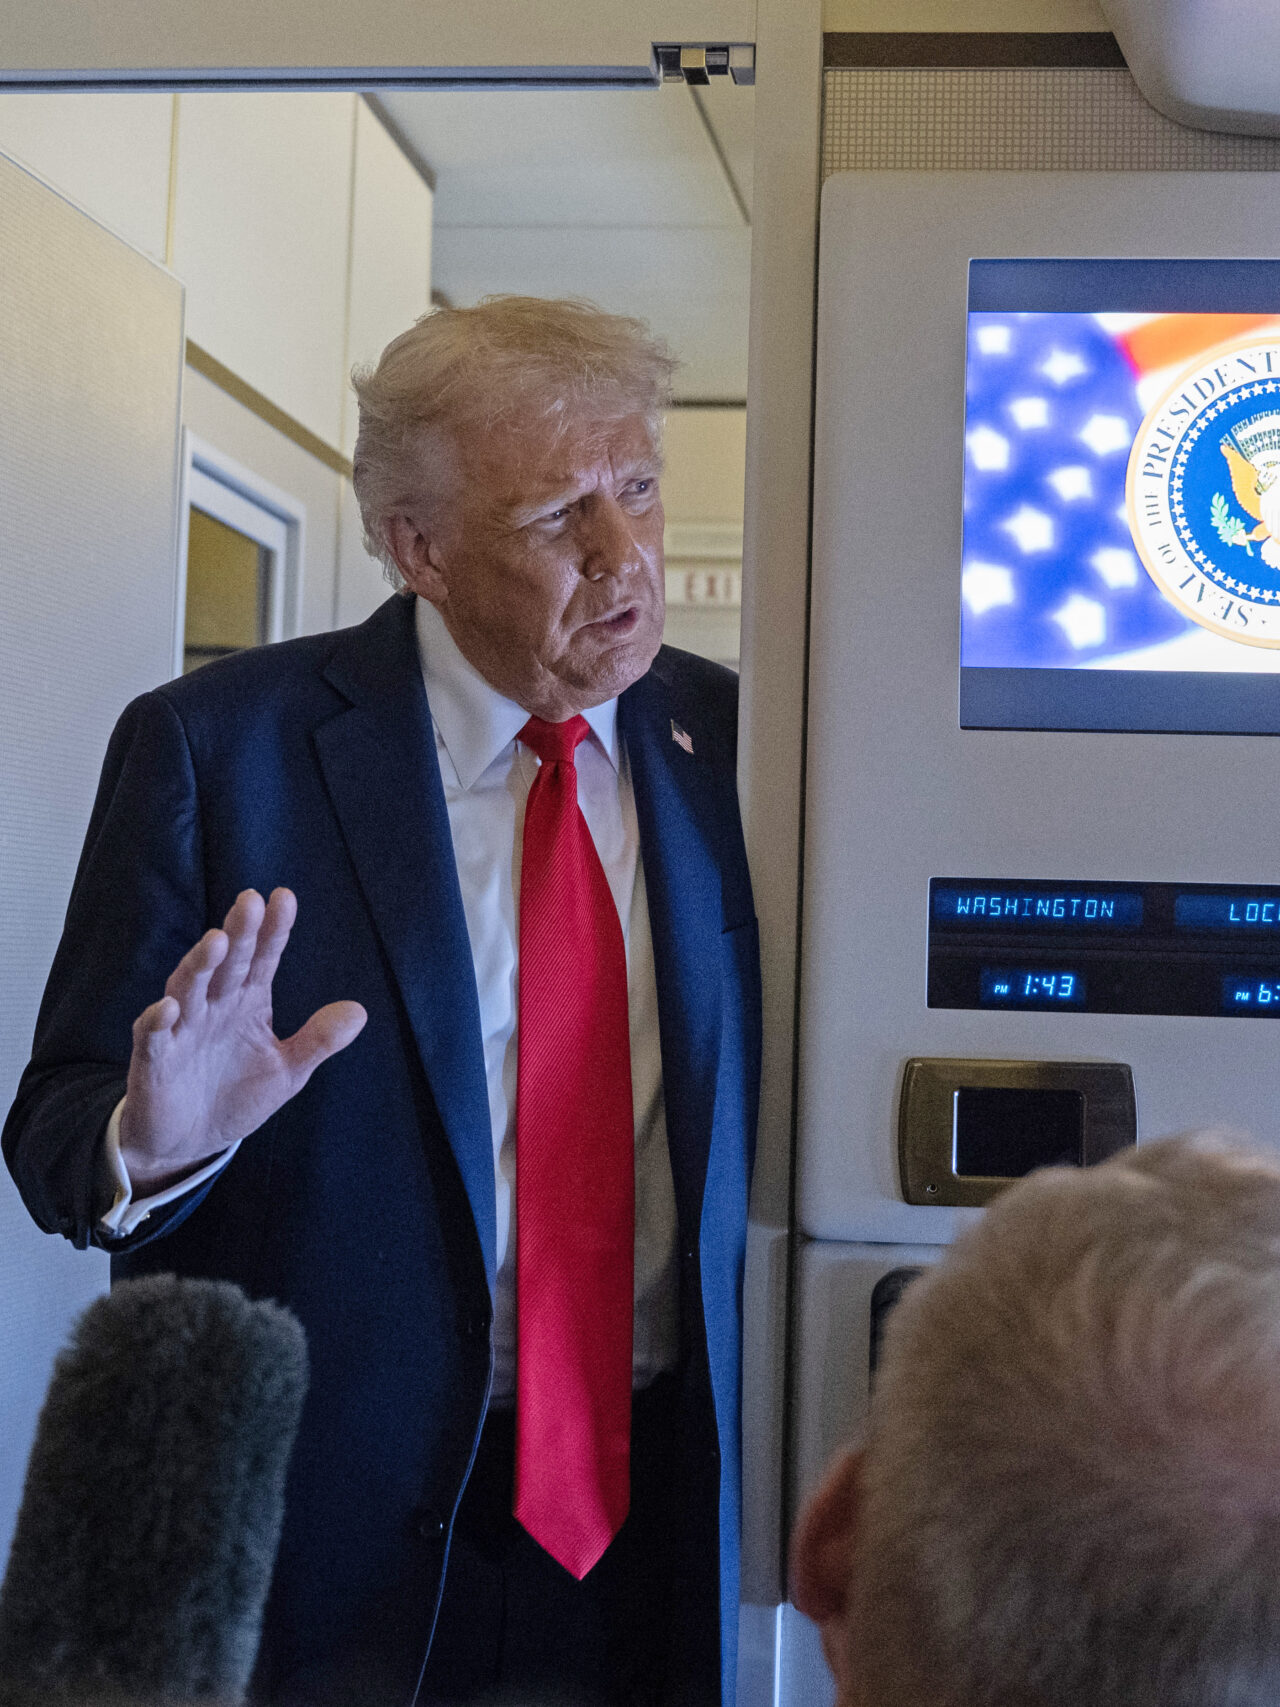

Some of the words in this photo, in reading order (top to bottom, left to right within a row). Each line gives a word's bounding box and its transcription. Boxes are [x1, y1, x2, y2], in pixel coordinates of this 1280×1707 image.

[1141, 350, 1279, 480] PRESIDENT
[1178, 572, 1253, 628] SEAL
[956, 896, 1115, 919] WASHINGTON
[994, 984, 1009, 994] PM
[1024, 974, 1075, 998] 1:43
[1234, 991, 1250, 1001] PM
